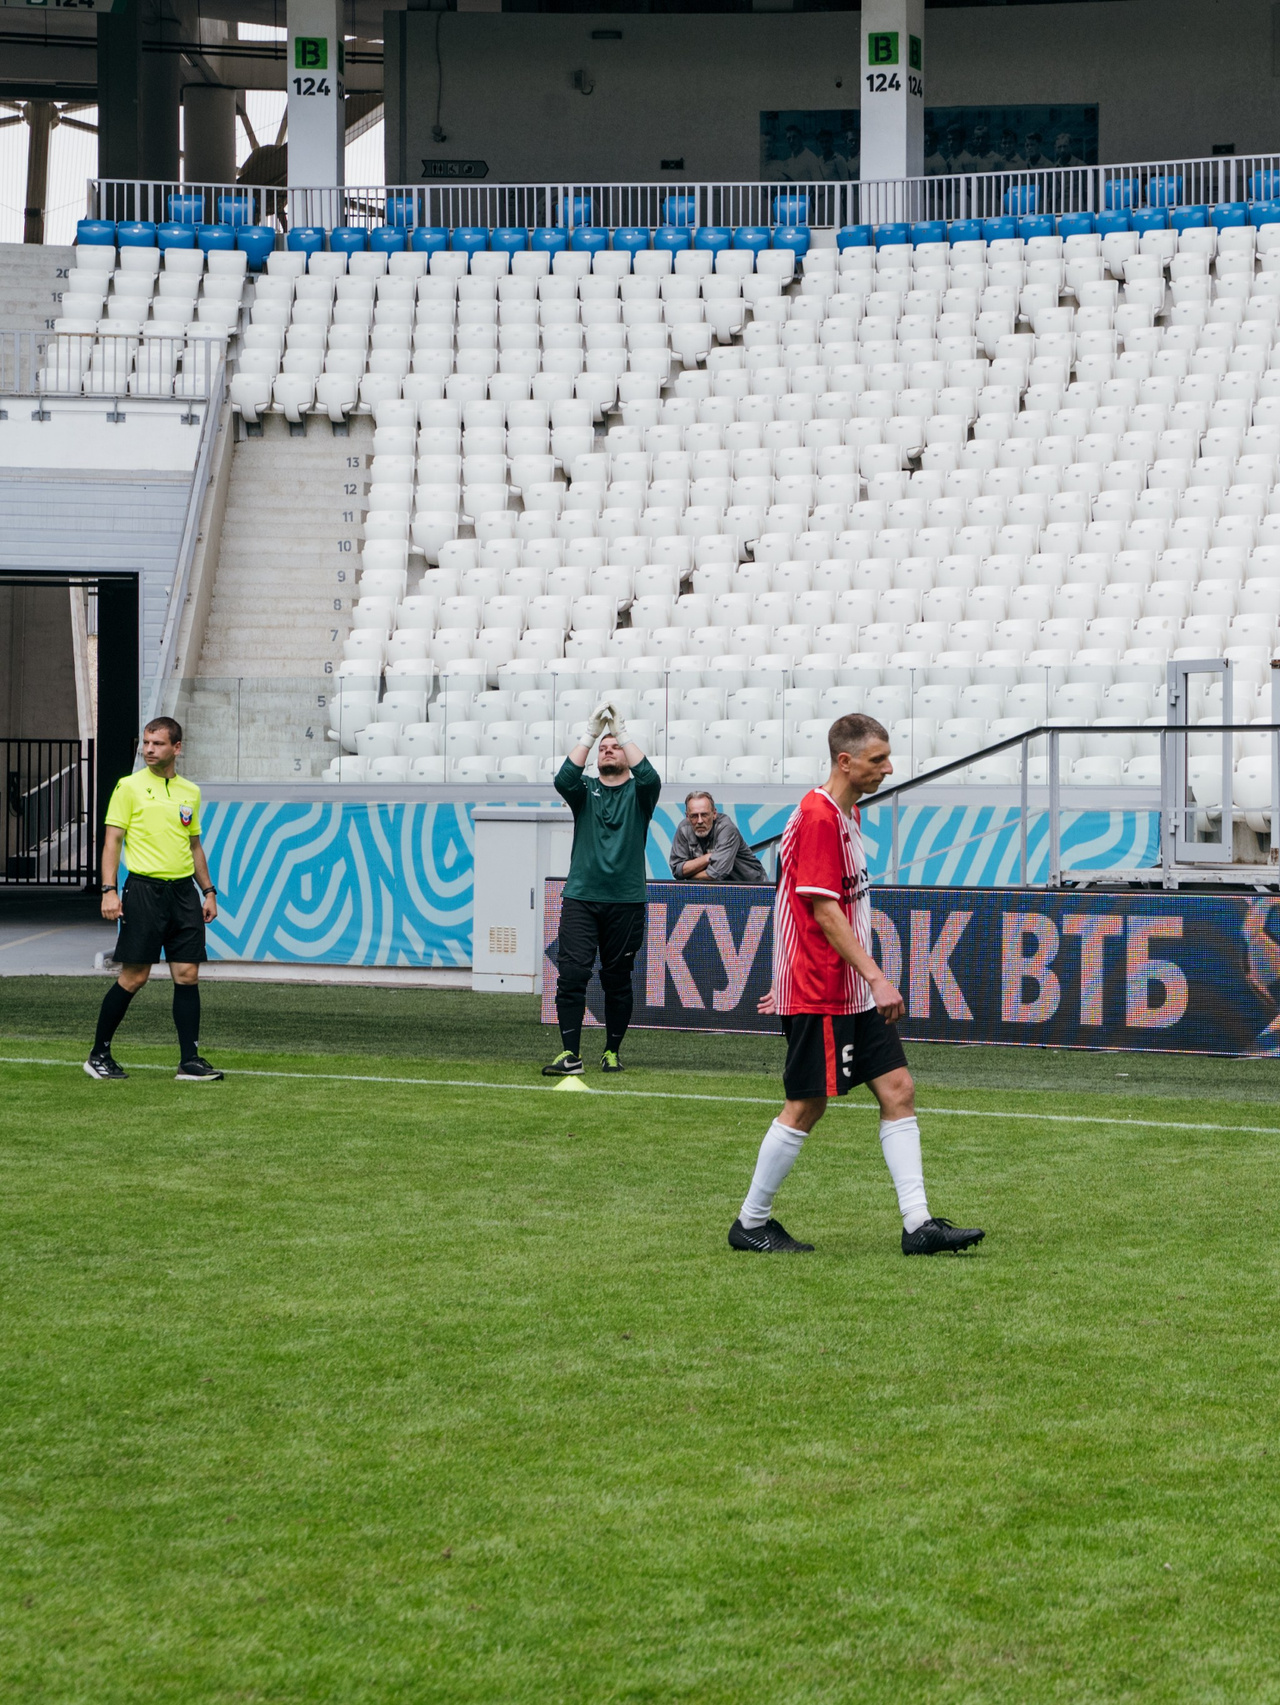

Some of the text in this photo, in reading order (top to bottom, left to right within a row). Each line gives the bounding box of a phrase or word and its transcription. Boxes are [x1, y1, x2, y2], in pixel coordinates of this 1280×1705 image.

[293, 77, 331, 96] 124
[866, 72, 901, 93] 124
[908, 75, 922, 98] 124
[346, 457, 360, 468] 13
[344, 483, 358, 495] 12
[342, 511, 354, 522] 11
[337, 540, 352, 552] 10
[337, 571, 346, 582] 9
[333, 599, 342, 611] 8
[330, 629, 339, 642] 7
[324, 662, 333, 674] 6
[317, 695, 326, 707] 5
[305, 726, 314, 740] 4
[293, 758, 302, 771] 3
[645, 903, 1189, 1028] КУК ВТБ
